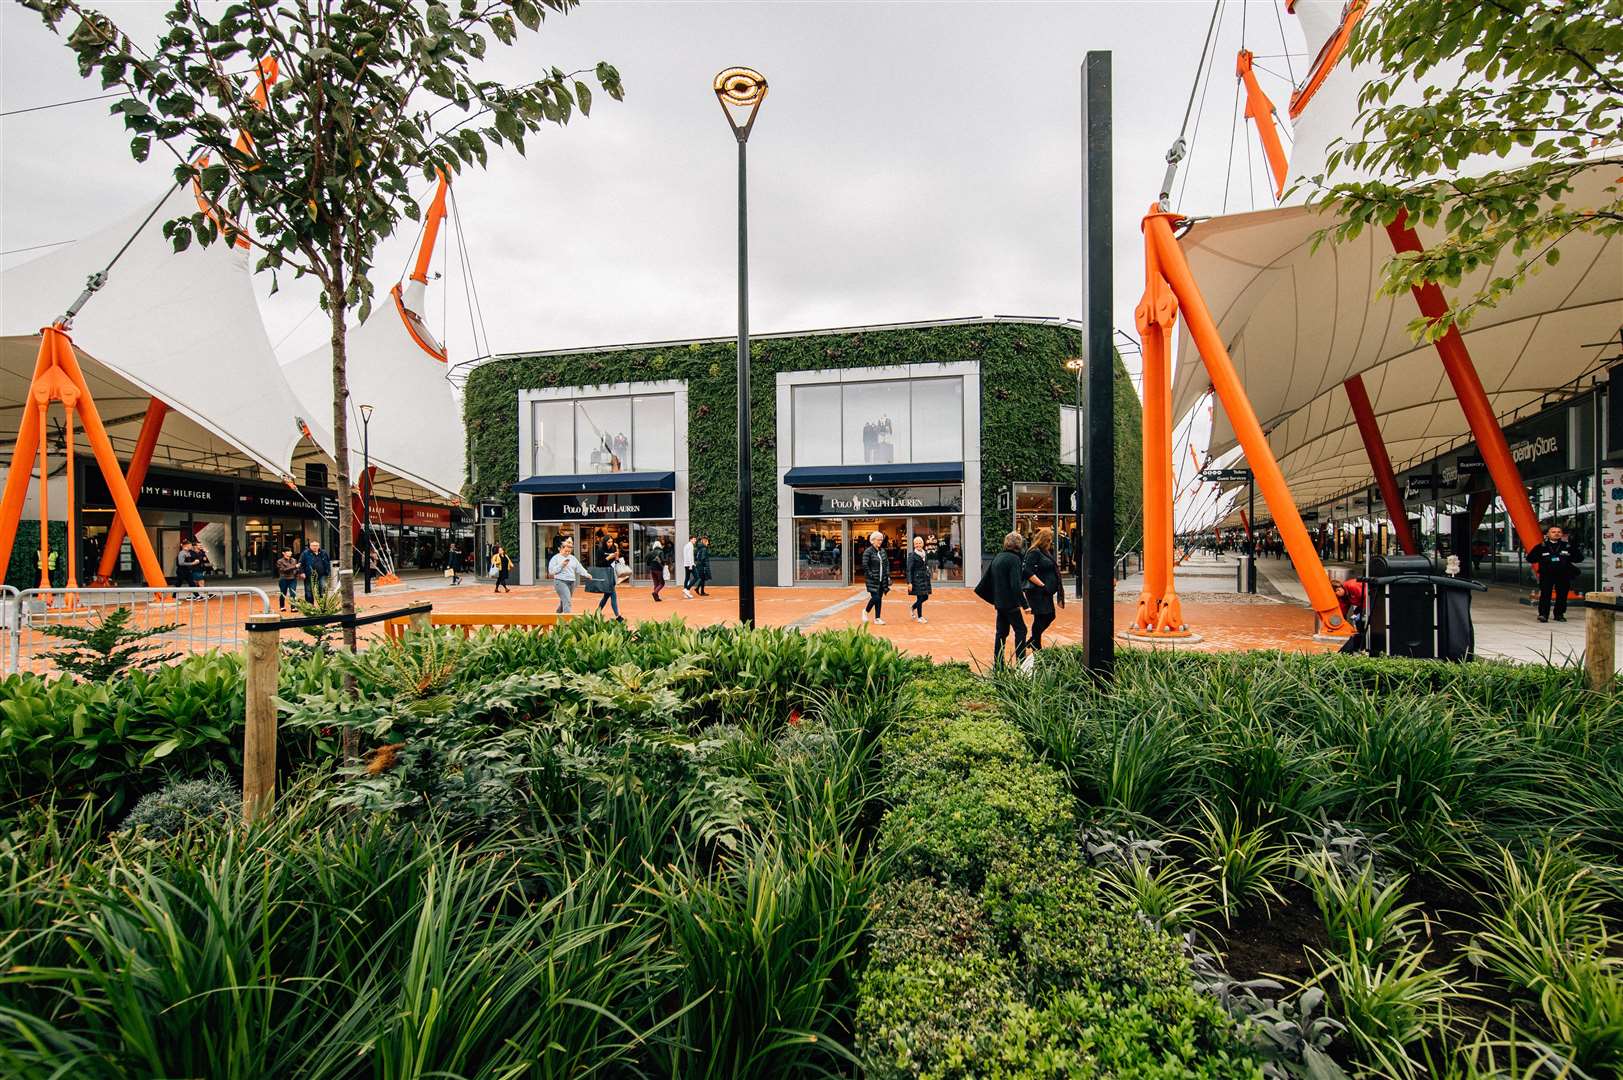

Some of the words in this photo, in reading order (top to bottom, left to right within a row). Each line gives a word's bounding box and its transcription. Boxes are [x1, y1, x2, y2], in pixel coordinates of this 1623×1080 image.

[173, 489, 211, 500] HILFIGER
[259, 497, 285, 506] TOMMY
[831, 498, 852, 509] POLO
[862, 497, 889, 508] RALPH
[890, 497, 924, 508] LAUREN
[563, 504, 581, 514] POLO
[589, 503, 612, 513] RALPH
[613, 503, 641, 513] LAUREN
